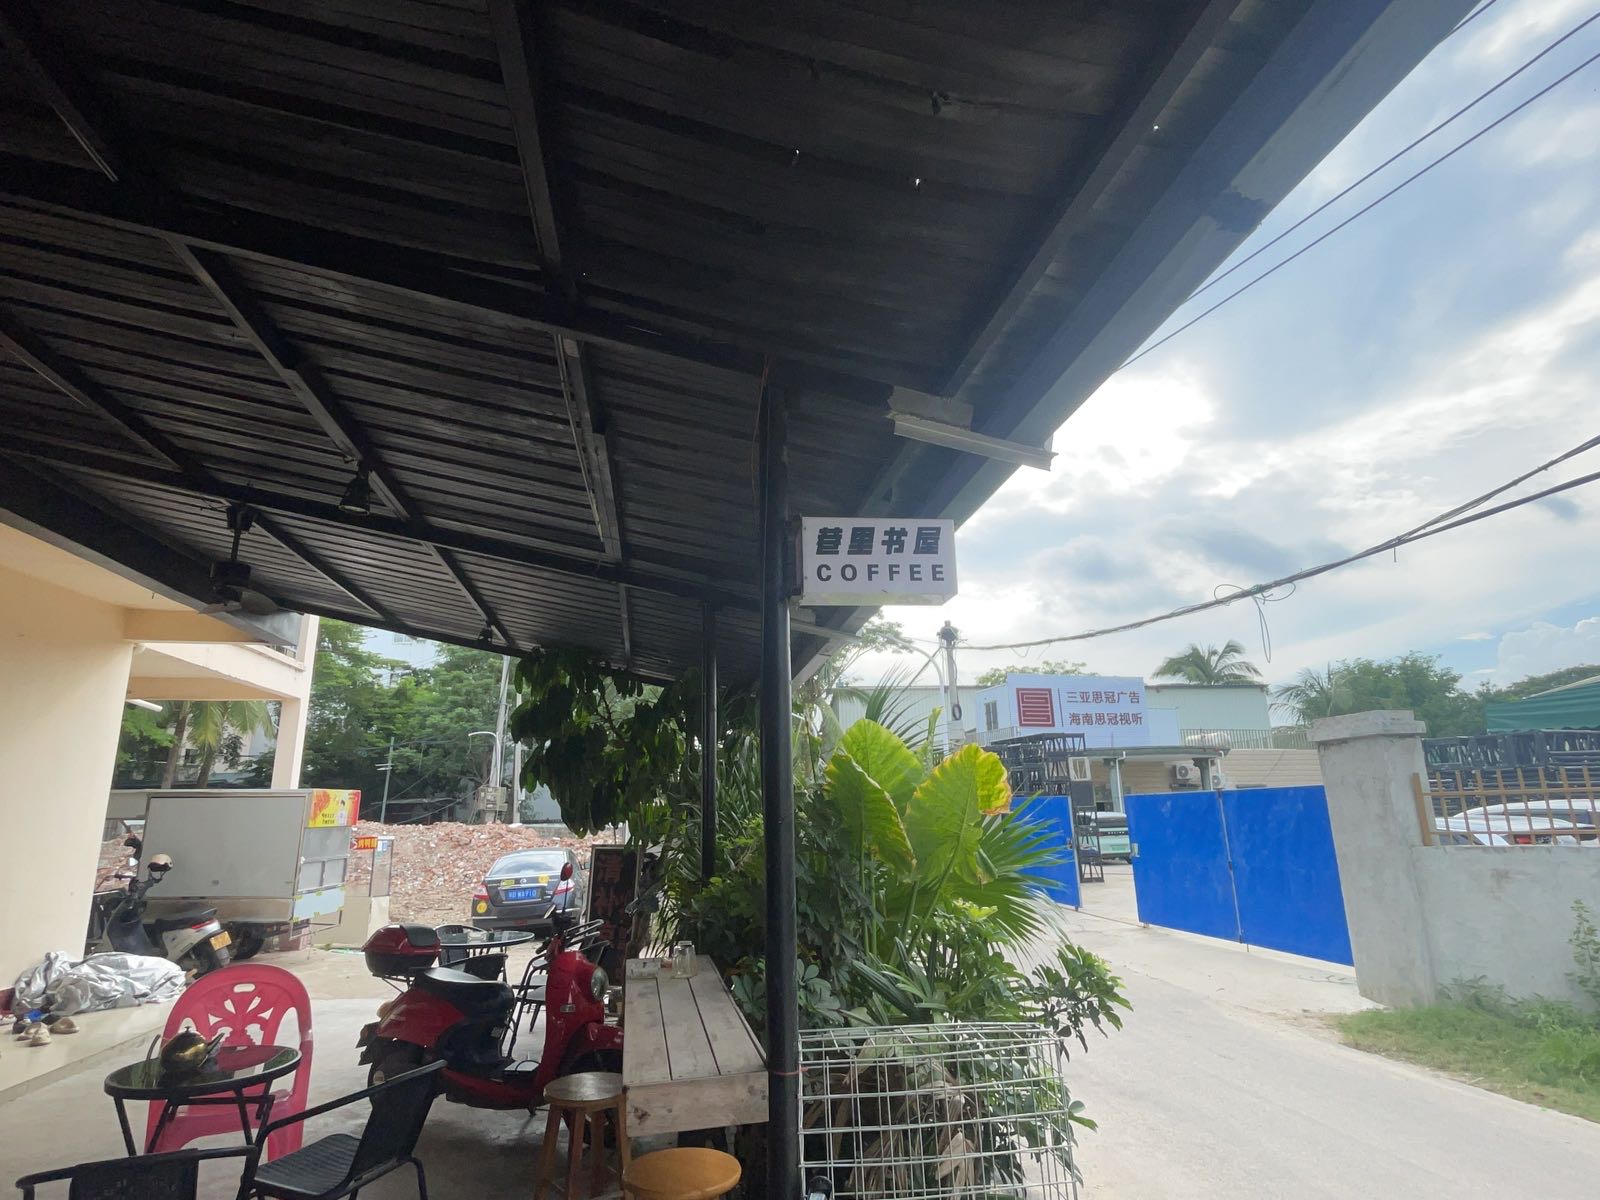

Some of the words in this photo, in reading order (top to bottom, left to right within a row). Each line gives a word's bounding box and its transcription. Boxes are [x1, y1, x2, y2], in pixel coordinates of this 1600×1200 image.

[815, 526, 941, 556] 巷里书屋
[816, 564, 945, 582] COFFEE
[1066, 691, 1141, 705] 三亚思冠广告
[1068, 712, 1143, 726] 海南思冠视听
